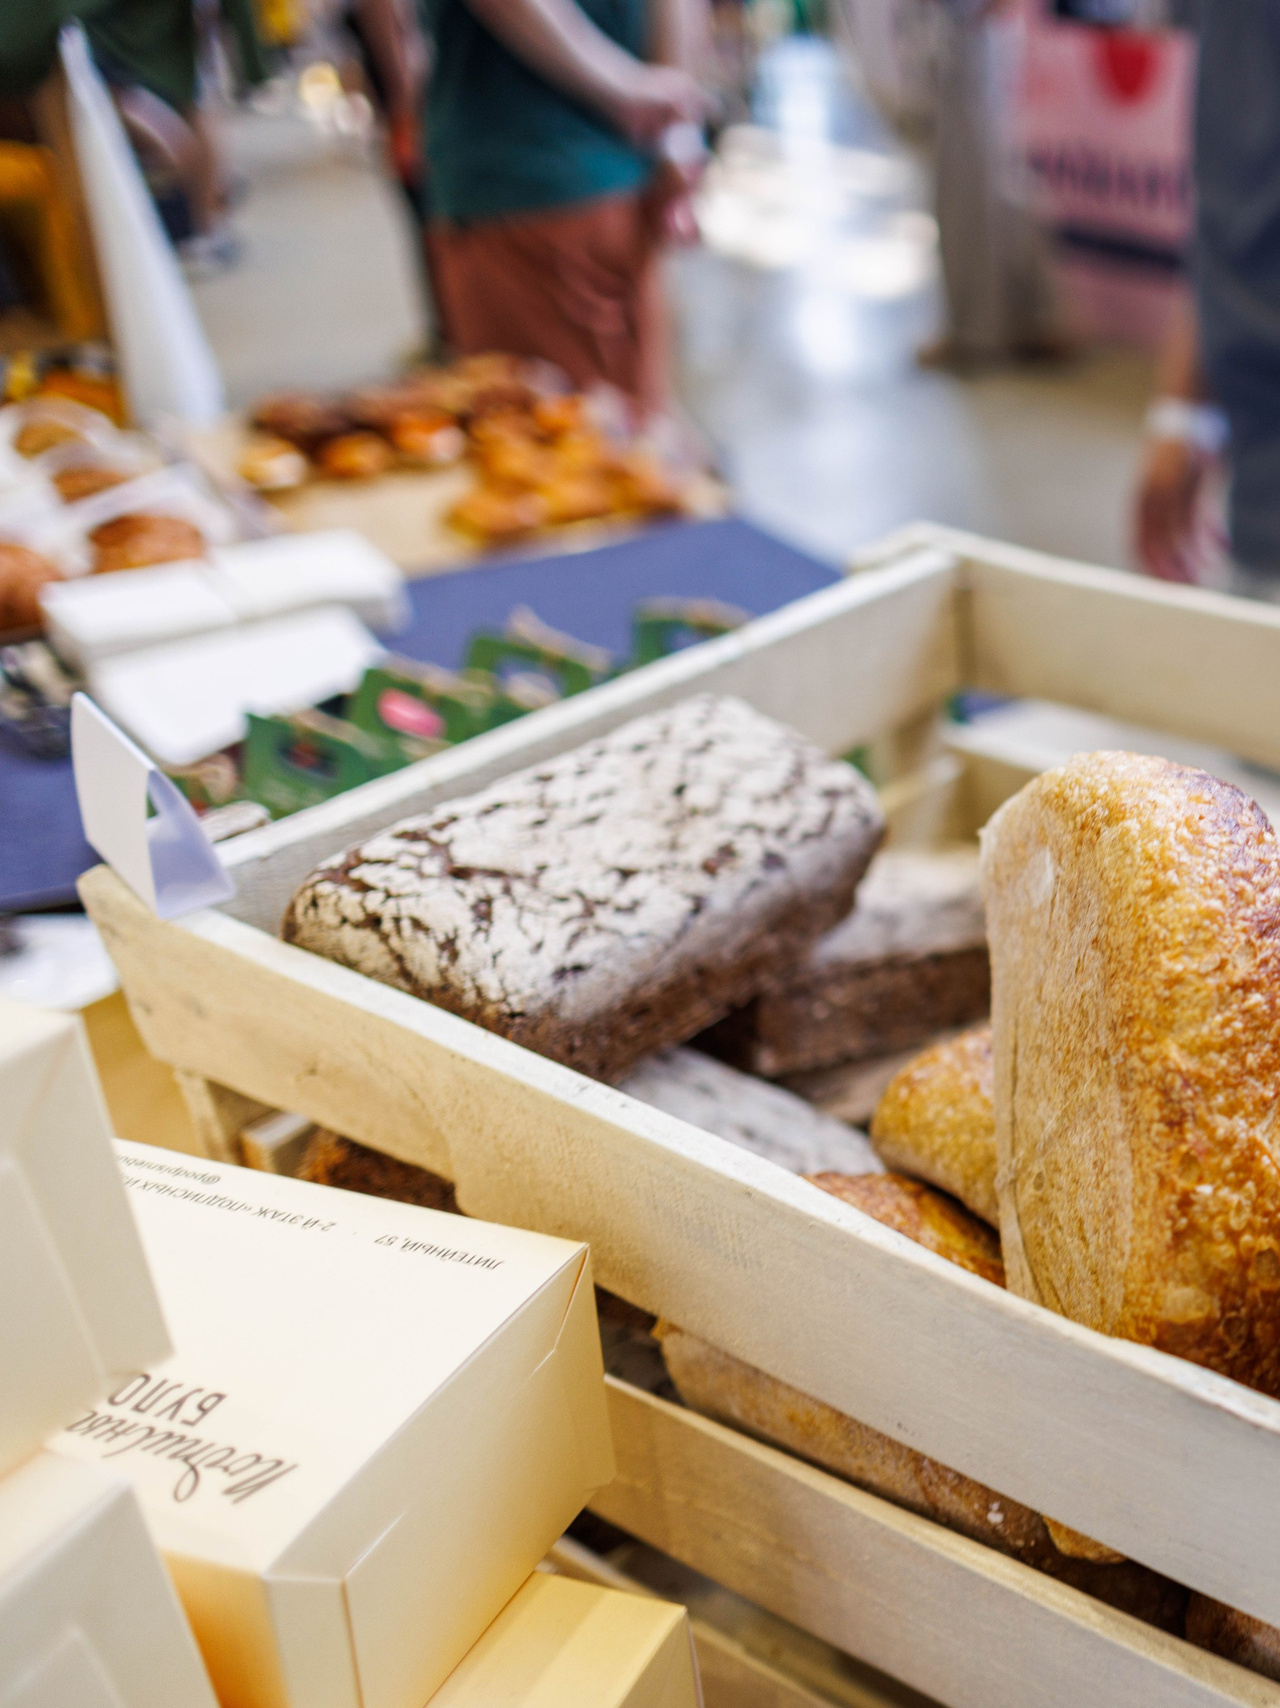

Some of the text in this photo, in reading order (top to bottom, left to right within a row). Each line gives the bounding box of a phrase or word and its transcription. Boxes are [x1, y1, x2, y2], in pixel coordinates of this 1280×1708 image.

[115, 1155, 222, 1185] @podpisniebu
[119, 1173, 505, 1270] ЛИТЕЙНЫЙ, 57 2-Й ЭТАЖ «ПОДПИСНЫХ И
